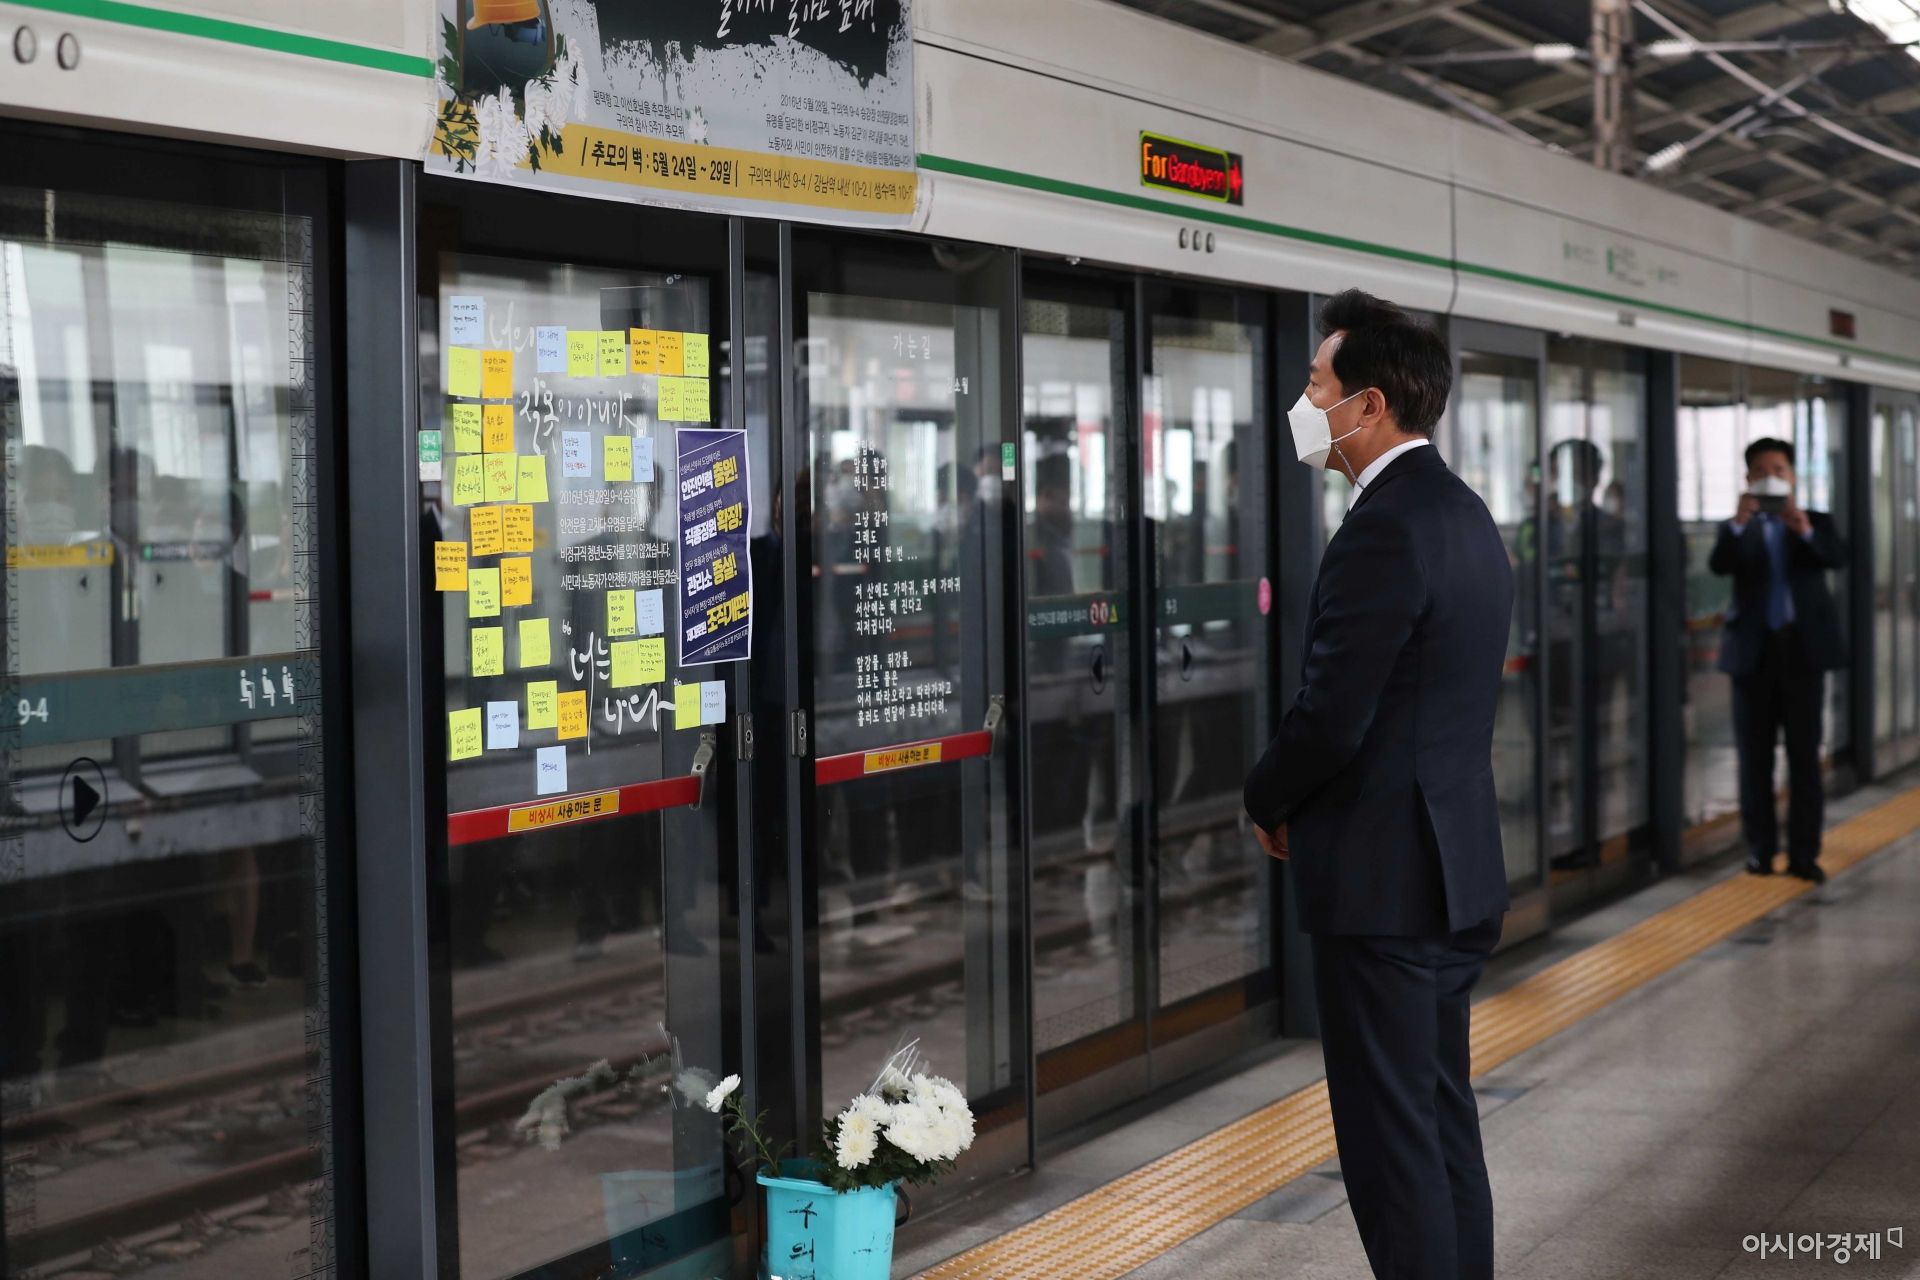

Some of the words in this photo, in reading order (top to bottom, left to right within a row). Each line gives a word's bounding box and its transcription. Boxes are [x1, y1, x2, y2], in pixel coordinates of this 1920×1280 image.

[651, 102, 683, 121] 추모합니다
[785, 115, 804, 132] 달리한
[805, 119, 830, 136] 비정규직
[768, 136, 793, 151] 노동자와
[794, 140, 813, 155] 시민이
[814, 142, 838, 158] 안전하게
[591, 140, 628, 171] 추모의
[632, 147, 642, 173] 벽
[652, 151, 669, 177] 5월
[672, 155, 696, 180] 24일
[710, 159, 732, 185] 29일
[748, 165, 772, 187] 구의역
[774, 169, 791, 189] 내선
[793, 172, 806, 188] 9-4
[814, 174, 835, 196] 강남역
[837, 177, 849, 197] 내선
[851, 181, 867, 197] 10-2
[874, 183, 897, 200] 성수역
[1143, 142, 1167, 179] For
[853, 456, 869, 474] 말을
[872, 456, 888, 474] 할까
[681, 469, 714, 501] 안전인력
[712, 455, 739, 488] 충원!
[853, 475, 869, 492] 하니
[560, 516, 587, 534] 안전문을
[587, 516, 607, 533] 고치다
[607, 516, 626, 533] 유명을
[626, 516, 646, 532] 달리한
[685, 516, 717, 547] 직종정원
[716, 501, 743, 533] 확정!
[854, 510, 870, 528] 그냥
[873, 509, 889, 528] 갈까
[854, 528, 878, 545] 그래도
[560, 545, 587, 562] 비정규직
[626, 543, 639, 560] 잊지
[638, 541, 671, 560] 않겠습니다.
[855, 546, 870, 564] 다시
[874, 546, 881, 563] 더
[885, 545, 893, 563] 한
[896, 545, 904, 562] 번
[560, 573, 581, 591] 시민과
[581, 572, 607, 590] 노동자가
[607, 571, 627, 588] 안전한
[627, 569, 651, 586] 지하철을
[686, 568, 713, 597] 관리소
[712, 551, 738, 586] 증설!
[855, 583, 863, 600] 저
[867, 581, 890, 600] 산에도
[893, 579, 918, 598] 가마귀,
[922, 578, 937, 596] 들에
[706, 590, 750, 634] 조직개편!
[855, 600, 886, 618] 서산에는
[890, 599, 897, 615] 해
[901, 598, 923, 615] 진다고
[856, 617, 897, 636] 지저귑니다.
[856, 653, 883, 673] 앞강물,
[884, 670, 898, 686] 물은
[857, 688, 872, 708] 어서
[875, 684, 913, 706] 따라오라고
[916, 681, 953, 701] 따라가자고
[18, 697, 49, 725] 9-4
[857, 707, 880, 727] 흘러도
[884, 704, 906, 723] 연달아
[878, 753, 896, 768] 비상시
[897, 749, 921, 765] 사용하는
[923, 747, 929, 760] 문
[528, 808, 554, 825] 비상시
[557, 800, 591, 819] 사용하는
[593, 797, 602, 812] 문
